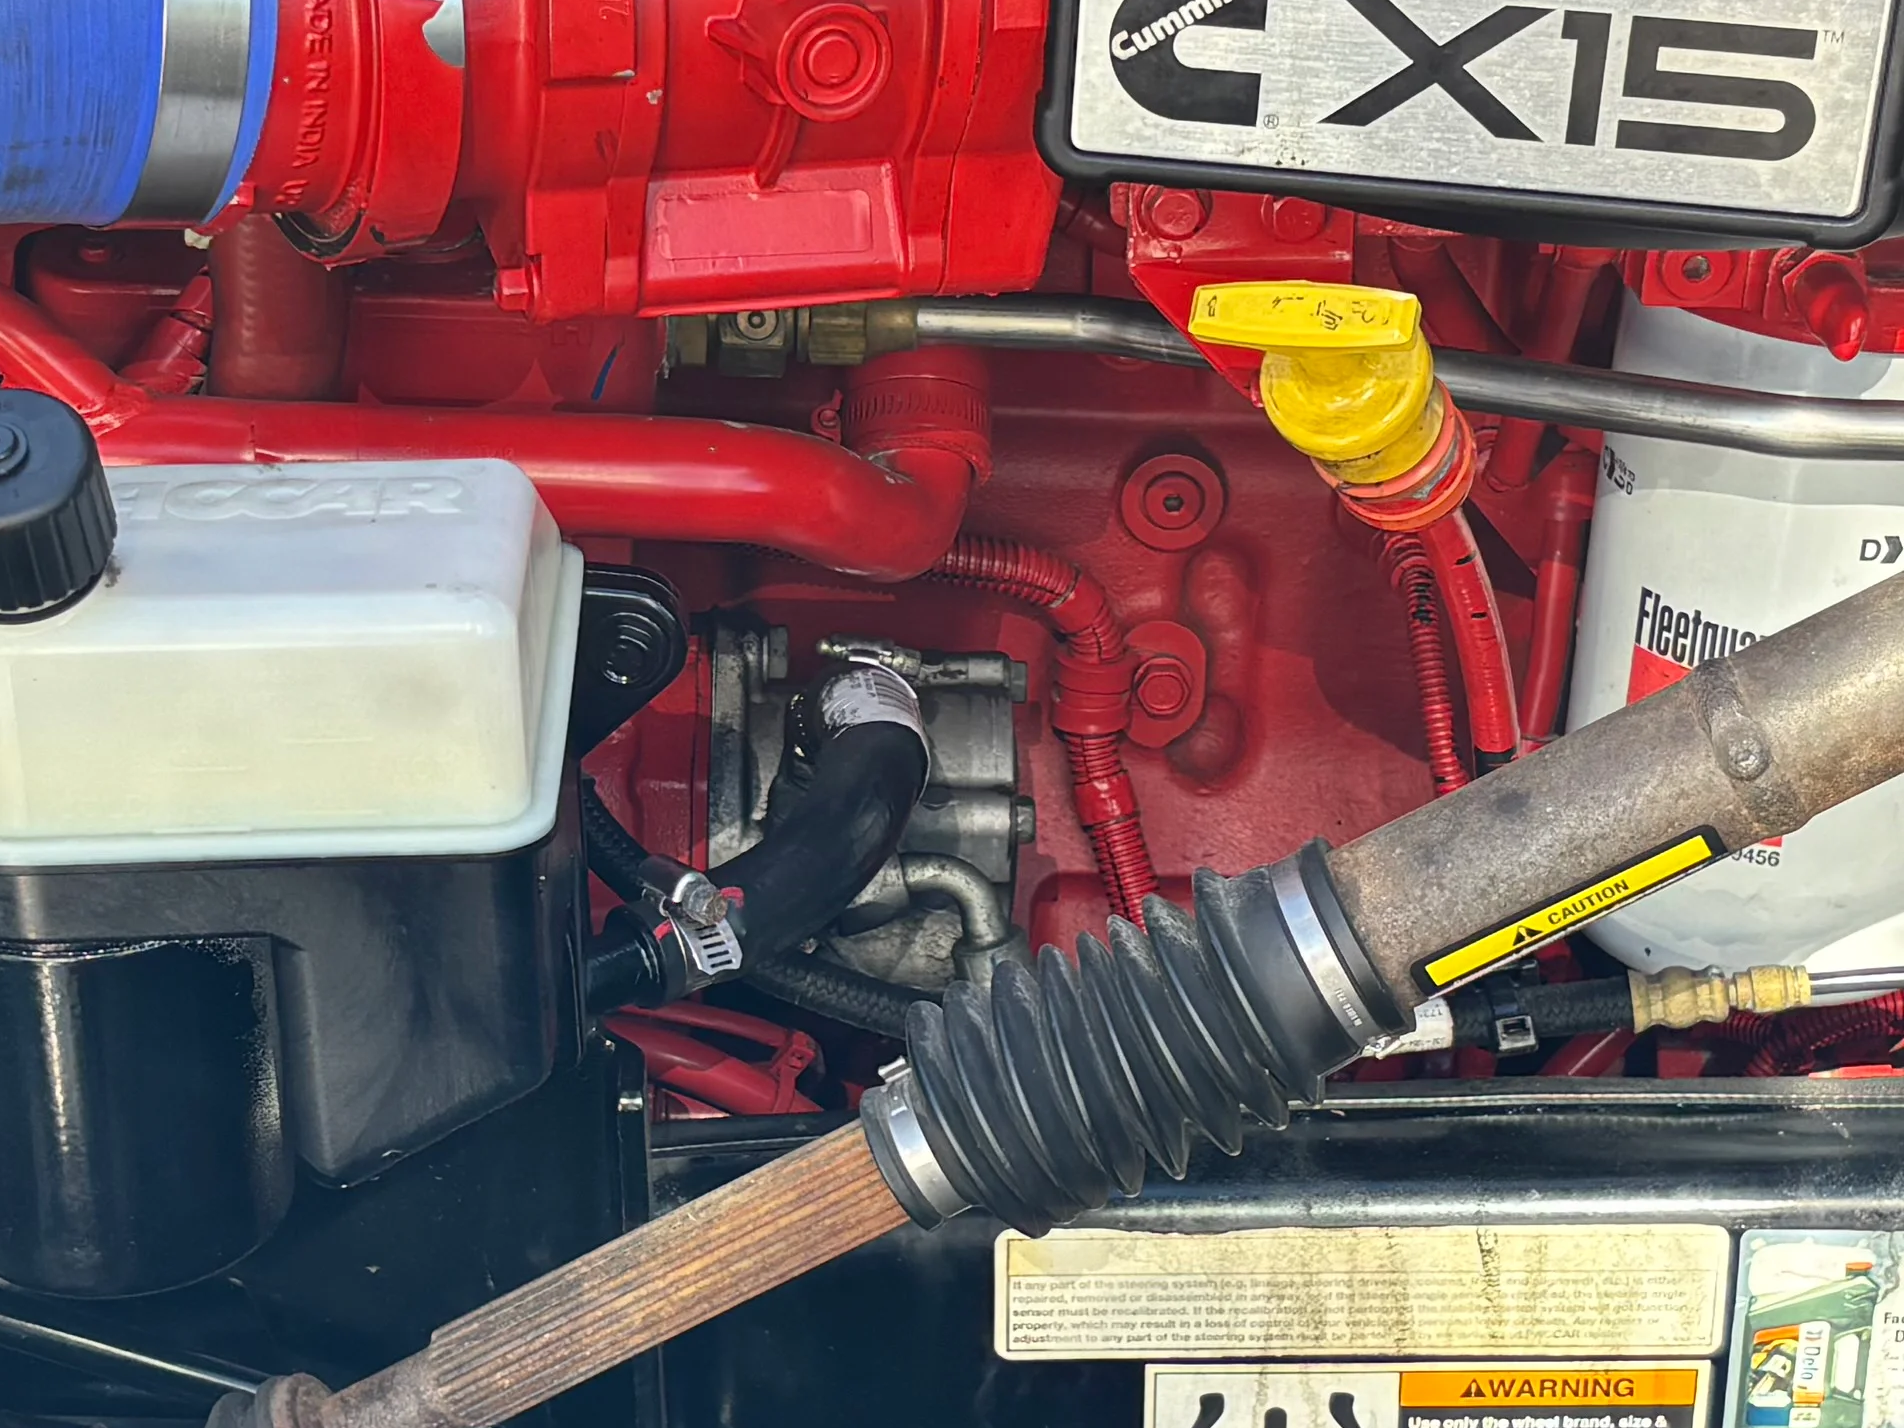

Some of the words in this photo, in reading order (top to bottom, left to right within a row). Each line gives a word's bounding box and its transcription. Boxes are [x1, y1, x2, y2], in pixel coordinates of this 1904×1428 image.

[305, 61, 331, 93] IN
[292, 101, 328, 168] INDIA
[118, 476, 465, 522] ACCAR
[1548, 880, 1630, 926] CAUTION
[1025, 1281, 1046, 1292] any
[1050, 1280, 1075, 1292] part
[1079, 1280, 1092, 1290] of
[1072, 1293, 1126, 1303] removed
[1130, 1295, 1142, 1303] or
[1146, 1293, 1231, 1303] disassembled
[1013, 1307, 1054, 1317] sensor
[1058, 1306, 1089, 1316] must
[1092, 1306, 1108, 1316] be
[1112, 1305, 1190, 1316] recalibrated.
[1207, 1305, 1225, 1315] the
[1071, 1320, 1108, 1330] which
[1111, 1322, 1136, 1332] may
[1140, 1319, 1175, 1329] result
[1179, 1319, 1190, 1329] in
[1205, 1319, 1230, 1328] loss
[1013, 1333, 1080, 1346] adjustment
[1101, 1334, 1122, 1344] any
[1126, 1332, 1151, 1344] part
[1155, 1332, 1168, 1342] of
[1172, 1332, 1191, 1342] the
[1489, 1378, 1635, 1398] WARNING
[1483, 1416, 1509, 1428] the
[1512, 1416, 1559, 1428] wheel
[1619, 1416, 1652, 1428] size
[1655, 1416, 1667, 1428] &
